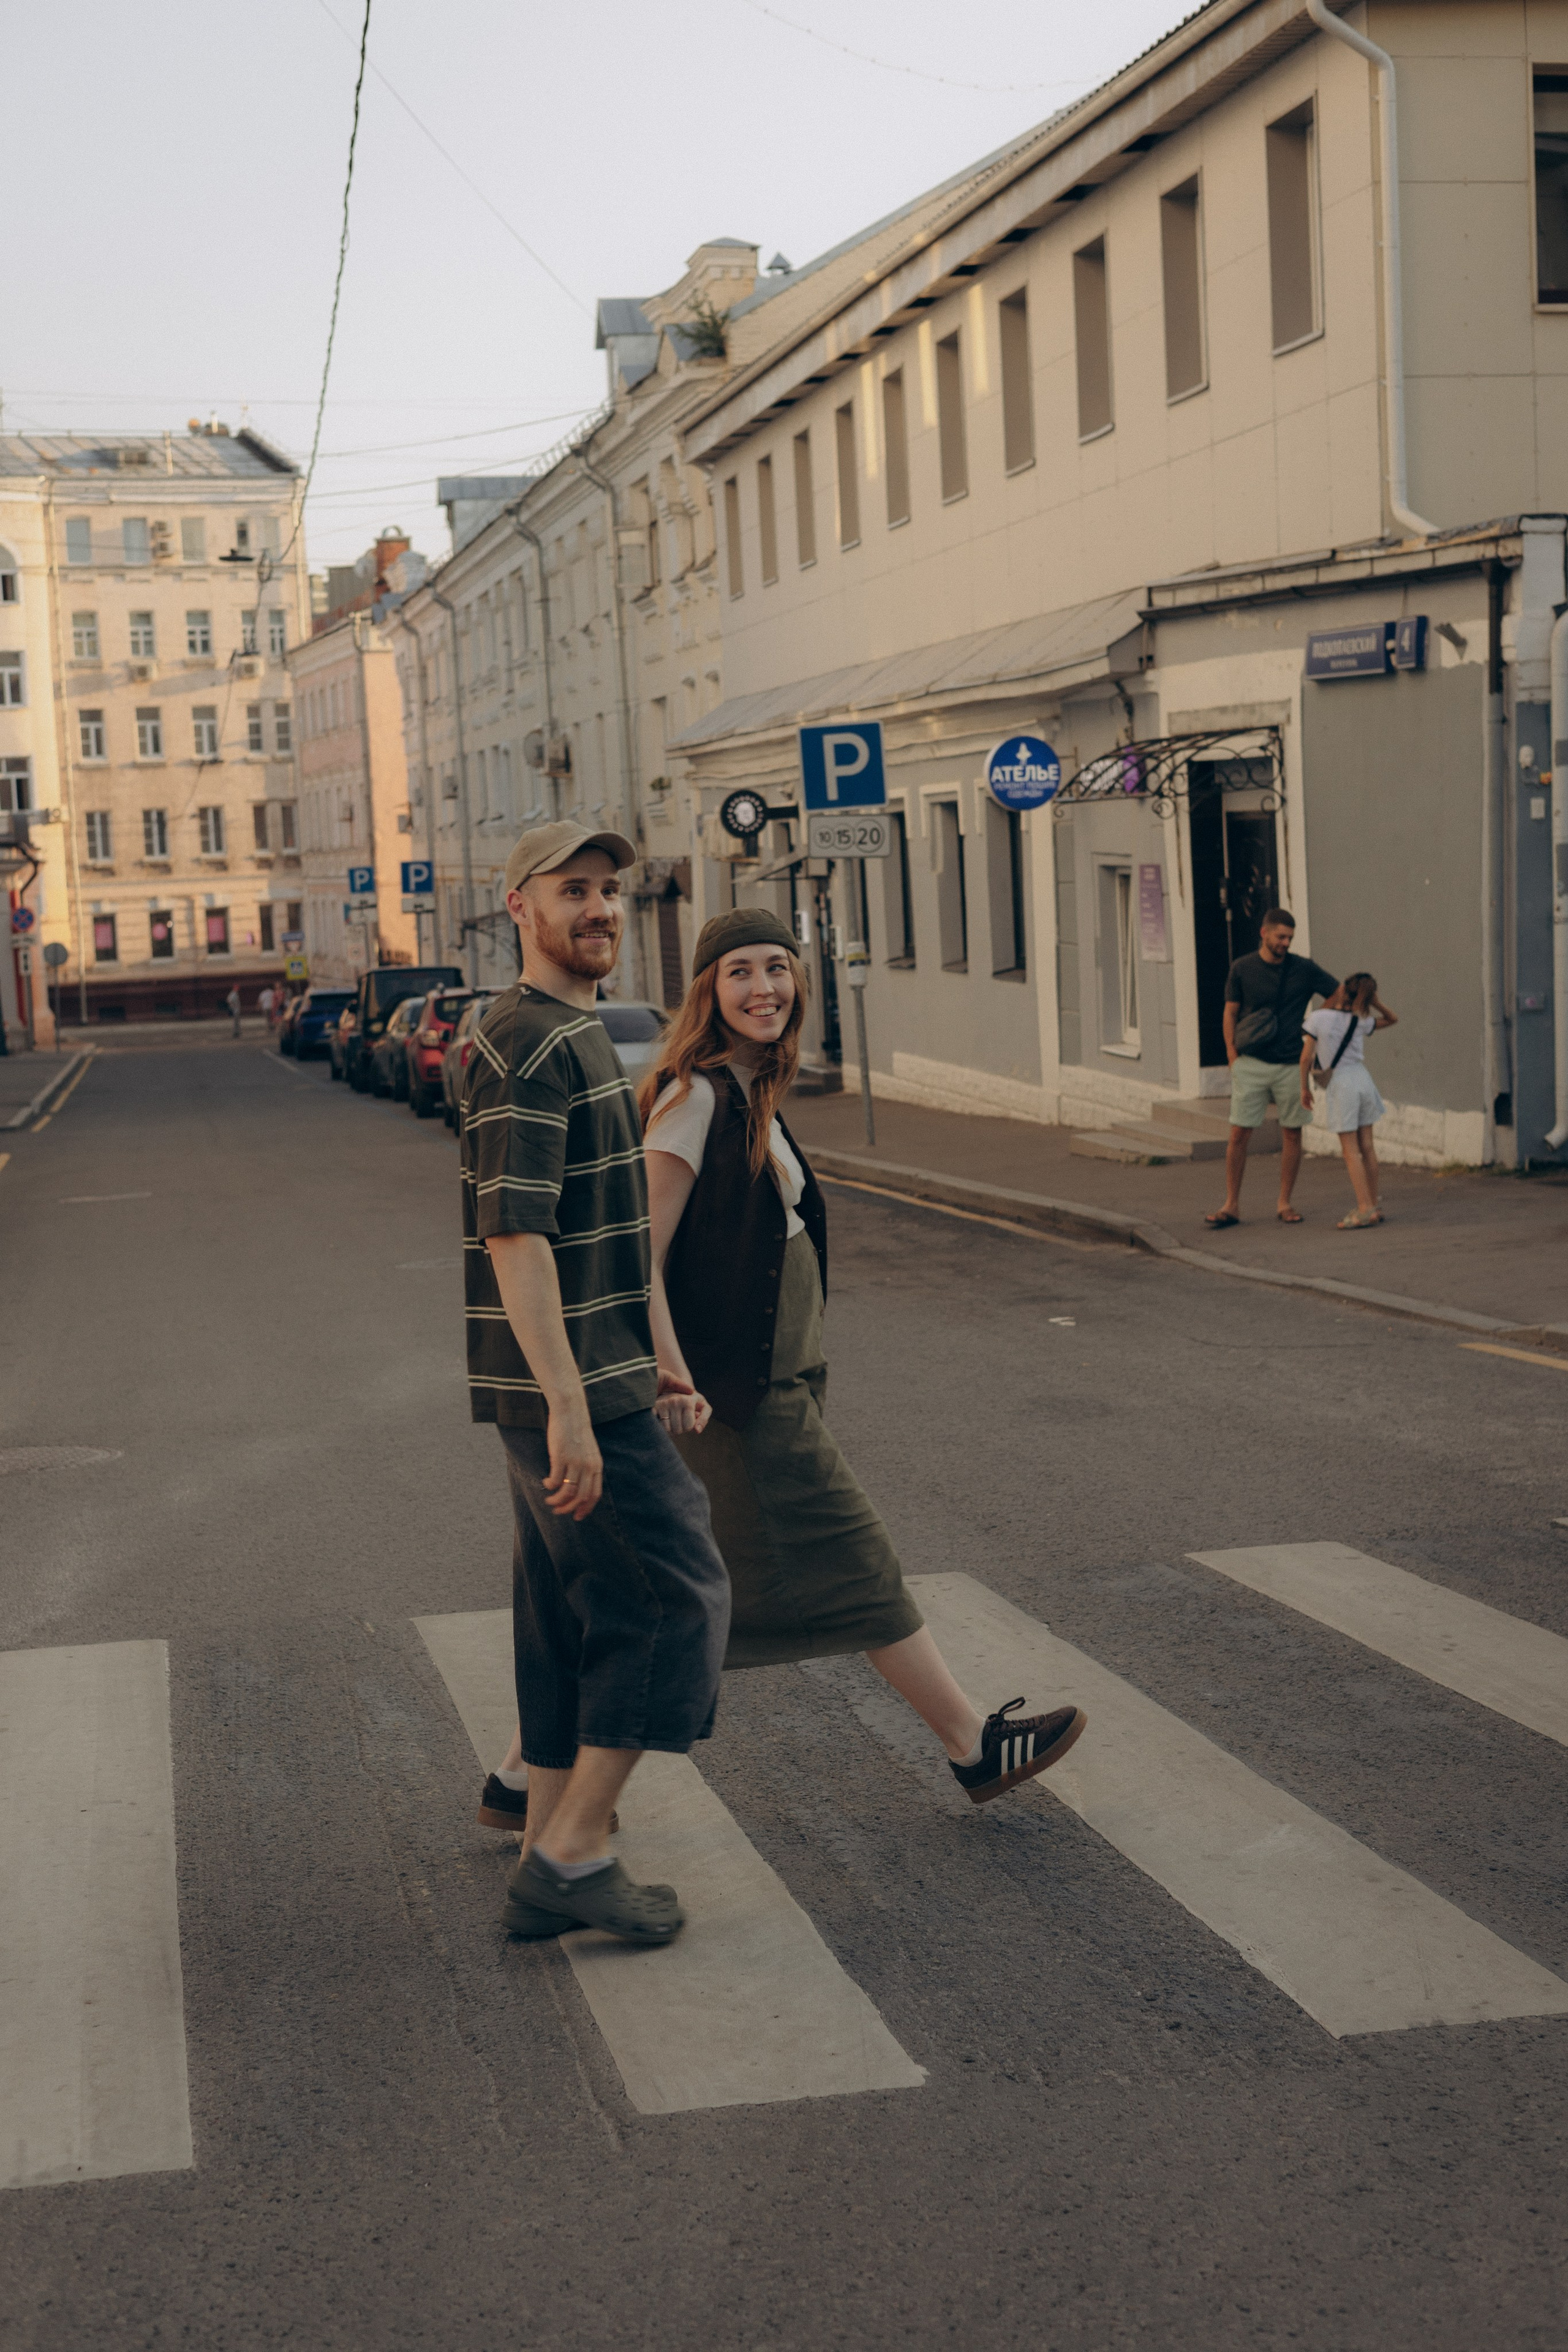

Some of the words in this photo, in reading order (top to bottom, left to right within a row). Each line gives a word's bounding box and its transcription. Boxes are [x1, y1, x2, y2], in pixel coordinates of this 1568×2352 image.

[1401, 627, 1411, 652] 4
[823, 733, 870, 801] P
[991, 764, 1059, 783] АТЕЛЬЕ
[820, 831, 832, 843] 10
[837, 829, 851, 844] 15
[858, 827, 881, 845] 20
[354, 870, 369, 891] P
[409, 864, 429, 891] P
